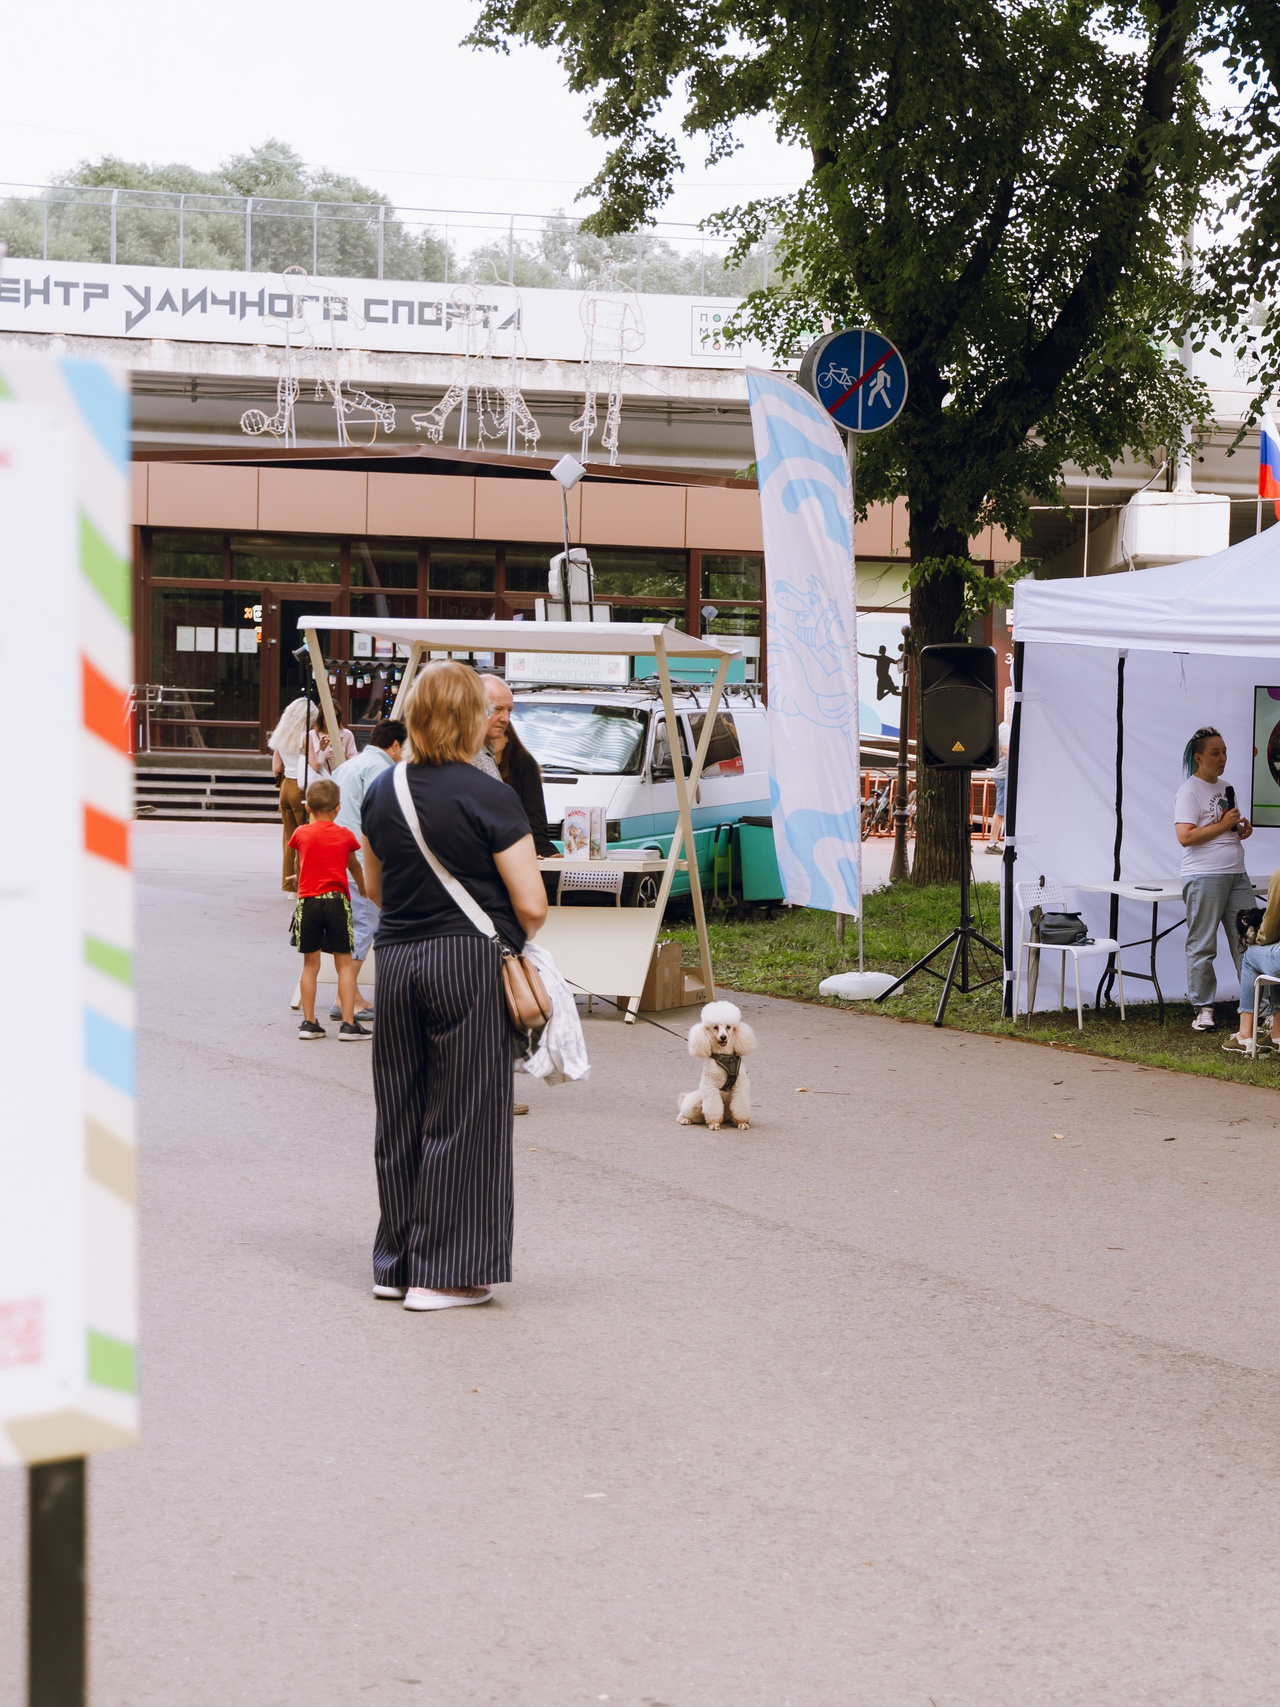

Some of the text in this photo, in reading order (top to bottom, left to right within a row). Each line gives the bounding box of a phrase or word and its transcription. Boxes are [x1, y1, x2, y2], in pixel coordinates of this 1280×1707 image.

[122, 284, 348, 334] УЛИЧНОГО
[364, 298, 521, 332] СПОРТА
[531, 668, 603, 681] МОРОЖЕНОЕ
